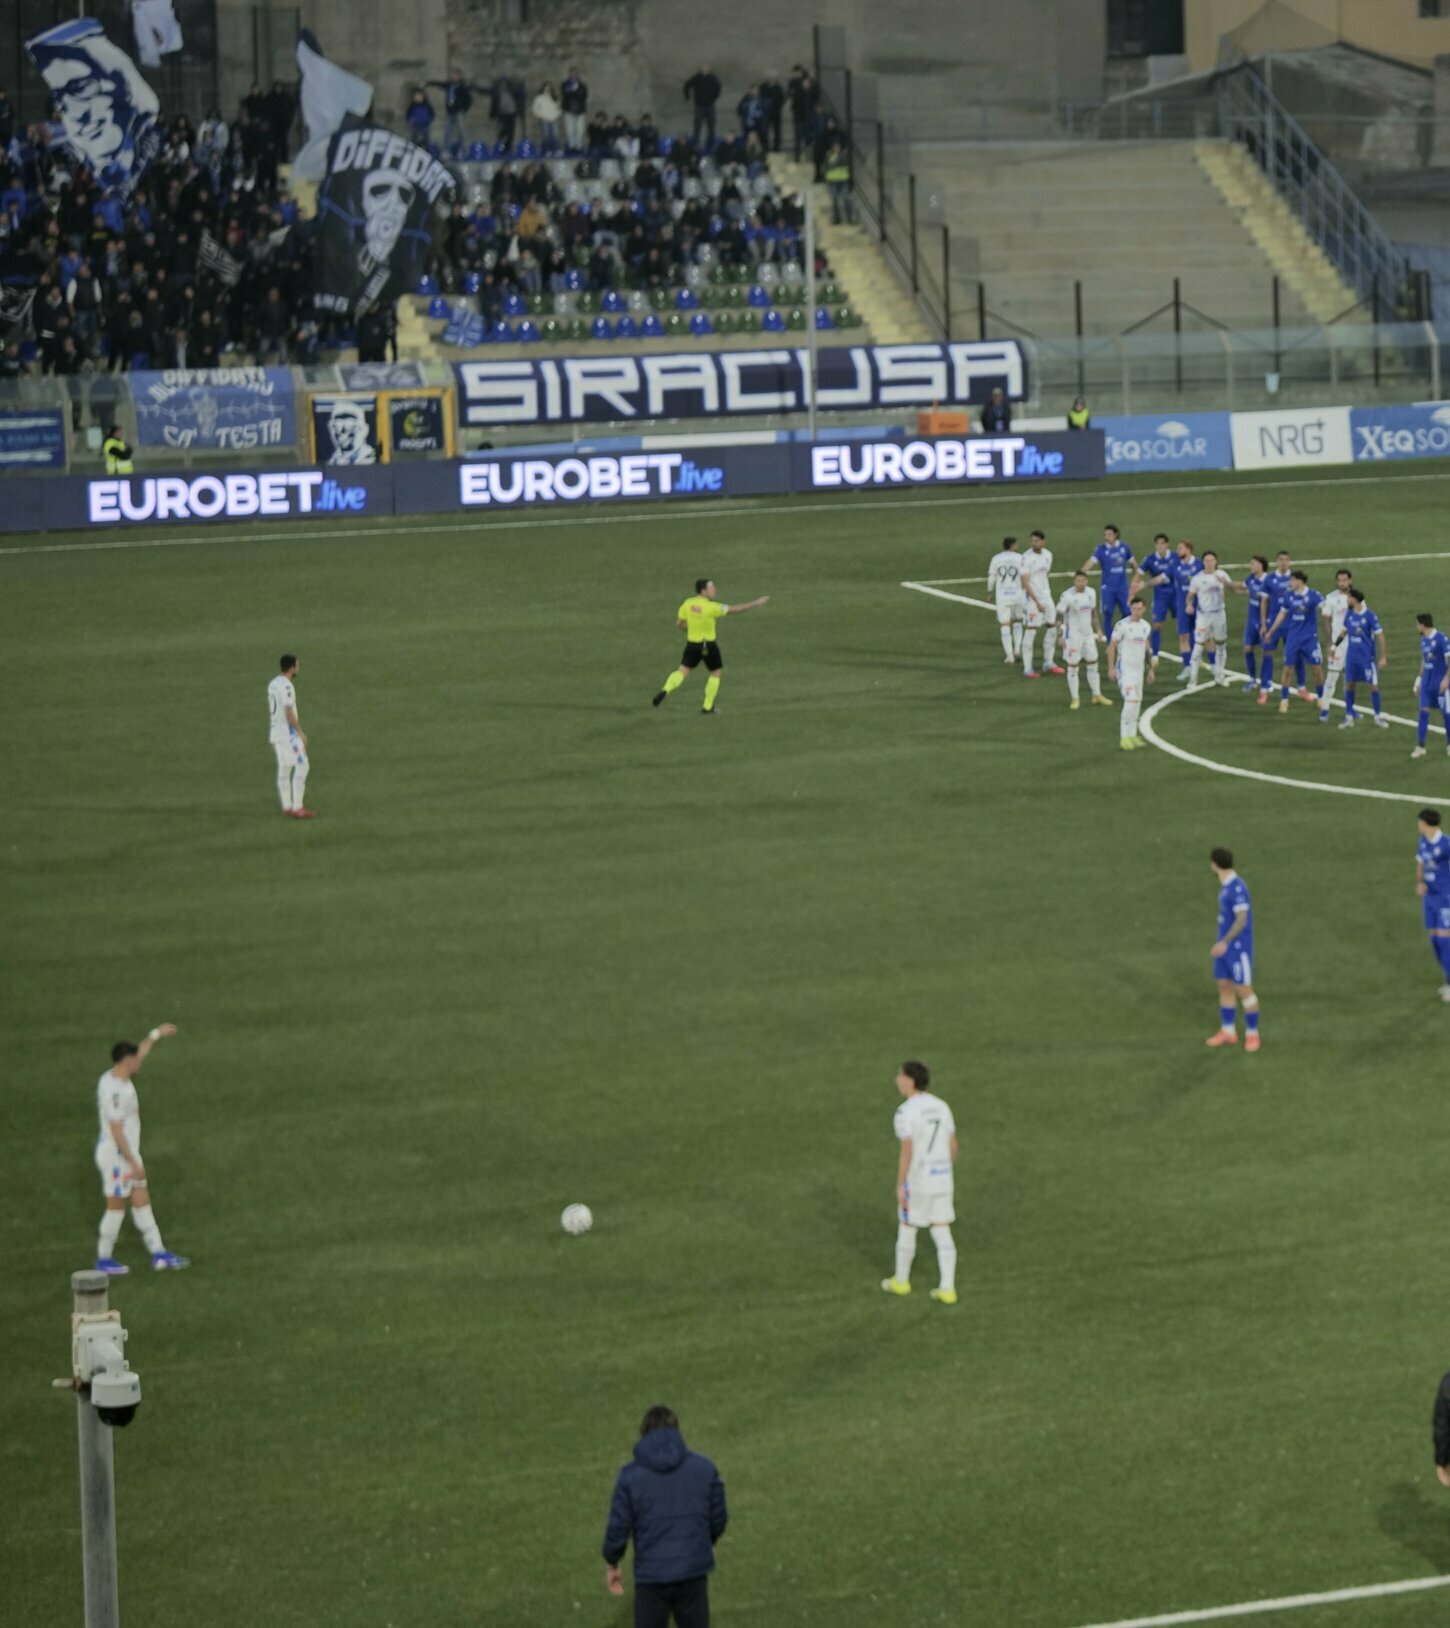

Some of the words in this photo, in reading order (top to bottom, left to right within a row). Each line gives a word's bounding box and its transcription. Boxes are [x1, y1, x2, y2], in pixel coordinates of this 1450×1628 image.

[460, 340, 1023, 422] SIRACUSA
[215, 418, 282, 450] TESTA
[997, 564, 1019, 584] 99
[927, 1118, 941, 1154] 7
